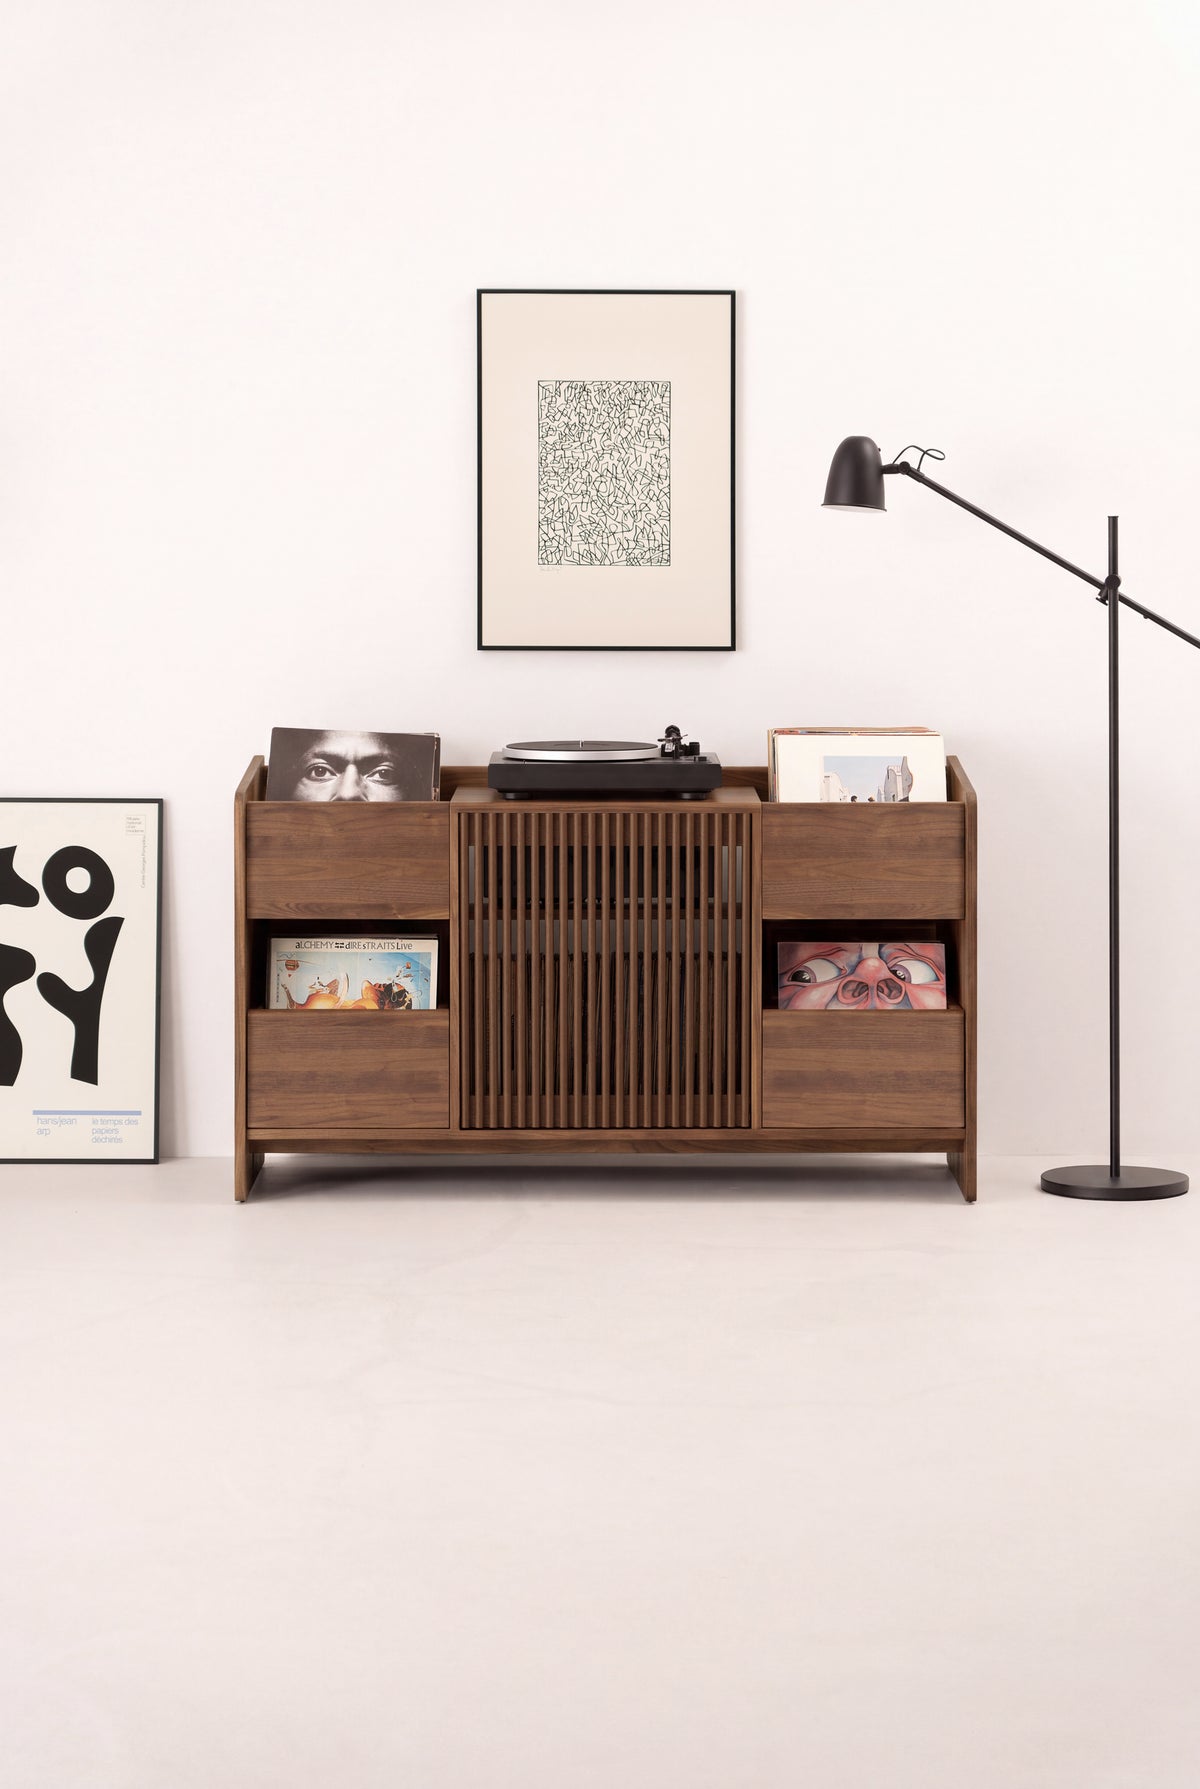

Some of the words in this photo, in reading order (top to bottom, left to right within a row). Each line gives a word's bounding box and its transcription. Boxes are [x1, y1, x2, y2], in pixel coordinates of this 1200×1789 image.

[396, 941, 413, 950] Live
[100, 1117, 123, 1127] temps
[124, 1117, 139, 1126] des
[36, 1127, 51, 1136] arp
[91, 1127, 119, 1136] papiers
